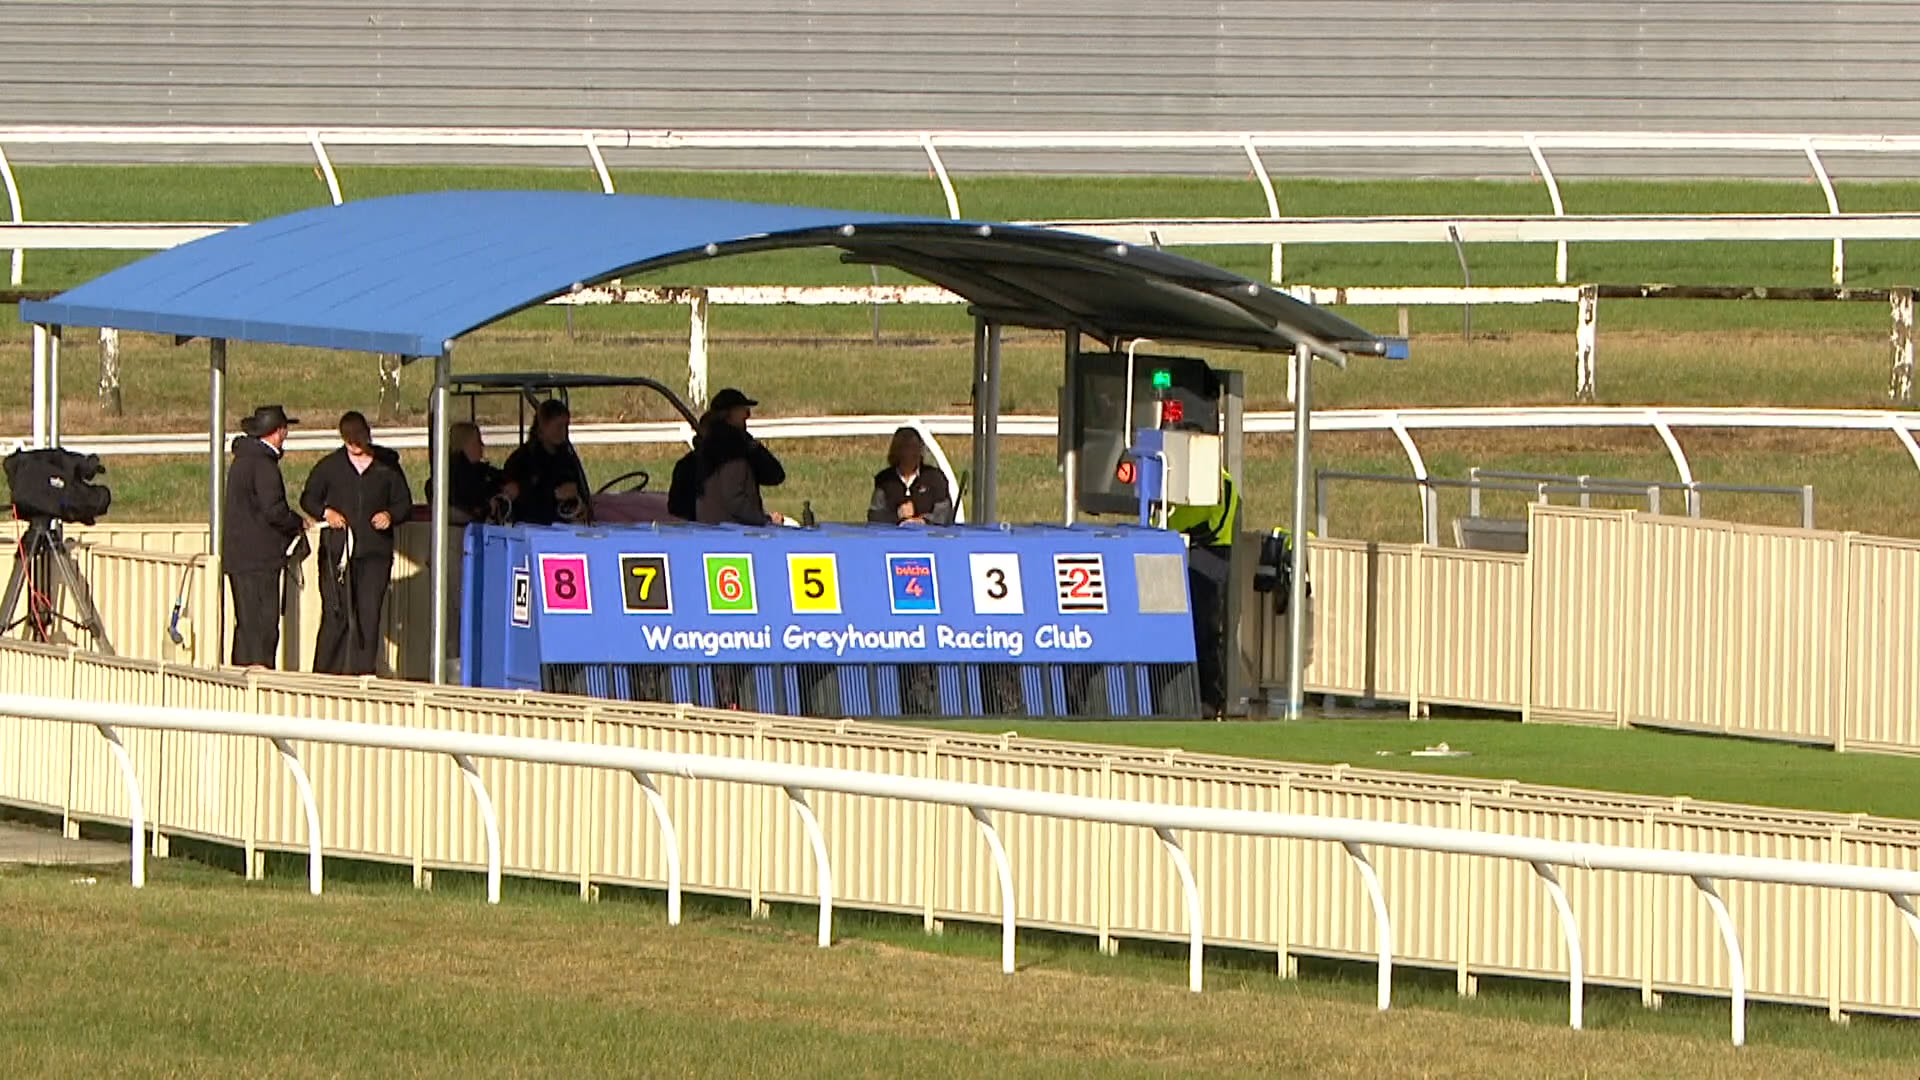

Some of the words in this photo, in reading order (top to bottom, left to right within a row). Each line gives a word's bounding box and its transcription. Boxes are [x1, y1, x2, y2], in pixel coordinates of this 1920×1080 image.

[554, 569, 577, 599] 8
[631, 567, 656, 601] 7
[717, 567, 742, 601] 6
[804, 569, 825, 599] 5
[905, 577, 925, 597] 4
[987, 568, 1009, 600] 3
[1068, 568, 1091, 598] 2
[642, 624, 770, 656] Wanganui
[783, 624, 926, 656] Greyhound
[937, 624, 1024, 656] Racing
[1035, 624, 1093, 649] Club
